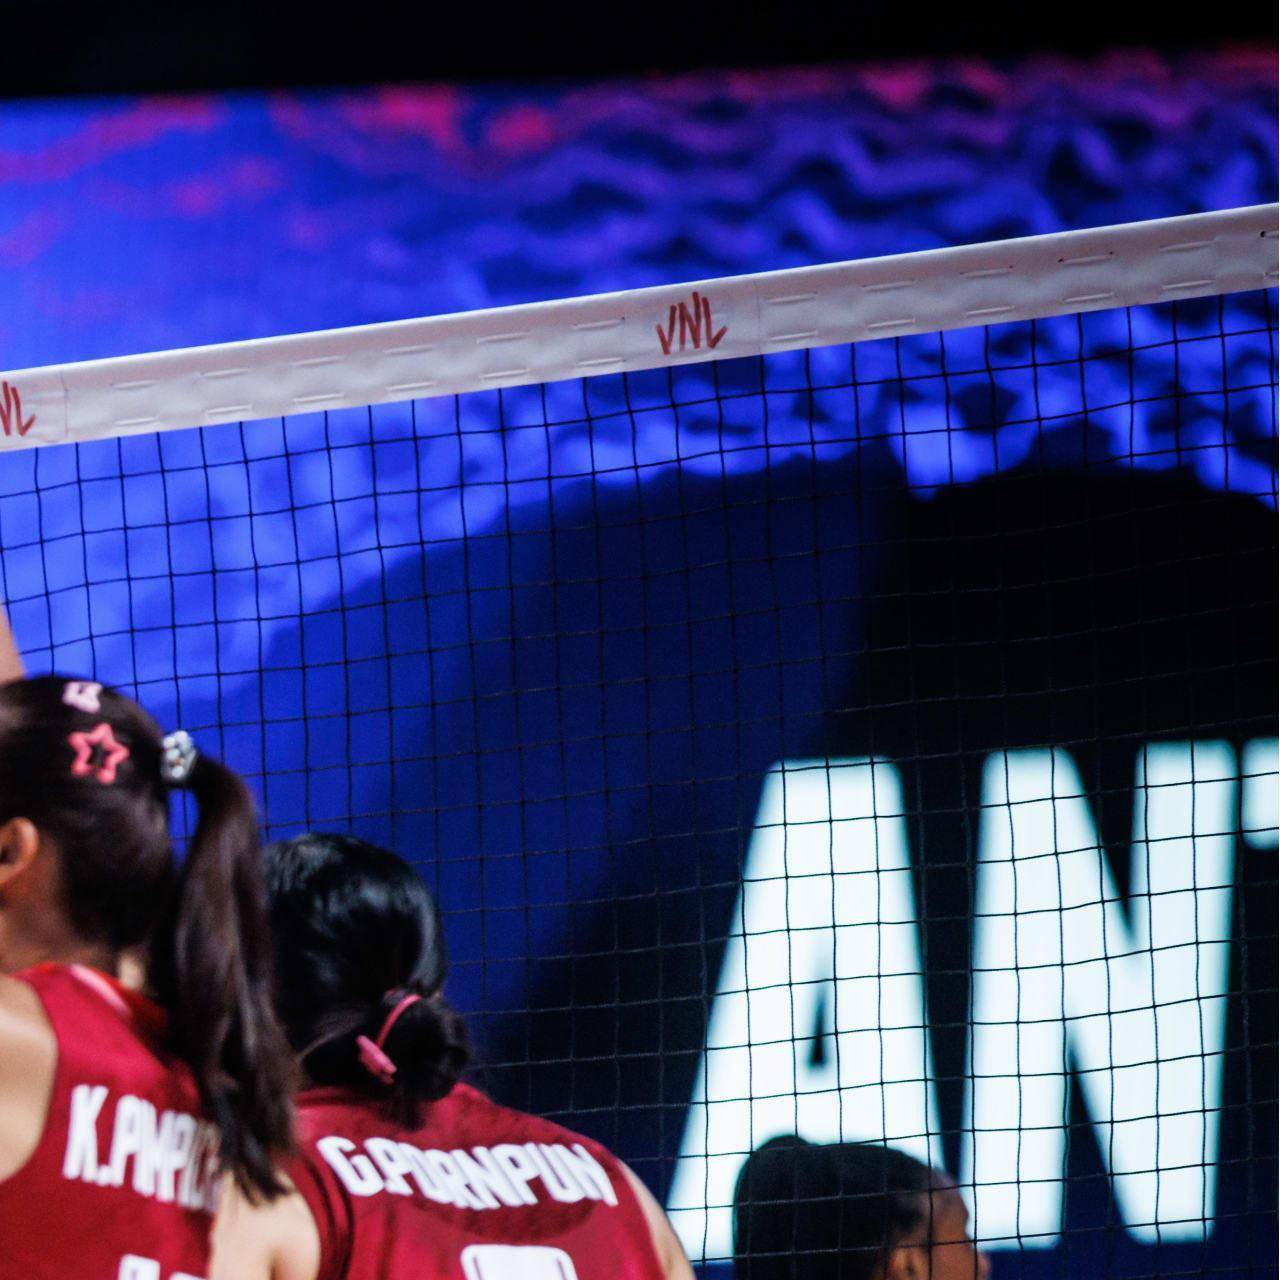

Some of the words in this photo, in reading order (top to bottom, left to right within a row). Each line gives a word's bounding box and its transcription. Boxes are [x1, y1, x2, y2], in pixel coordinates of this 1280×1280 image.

[656, 291, 728, 356] VNL
[665, 738, 1278, 1264] AN
[316, 1135, 619, 1211] G.PORNPUN
